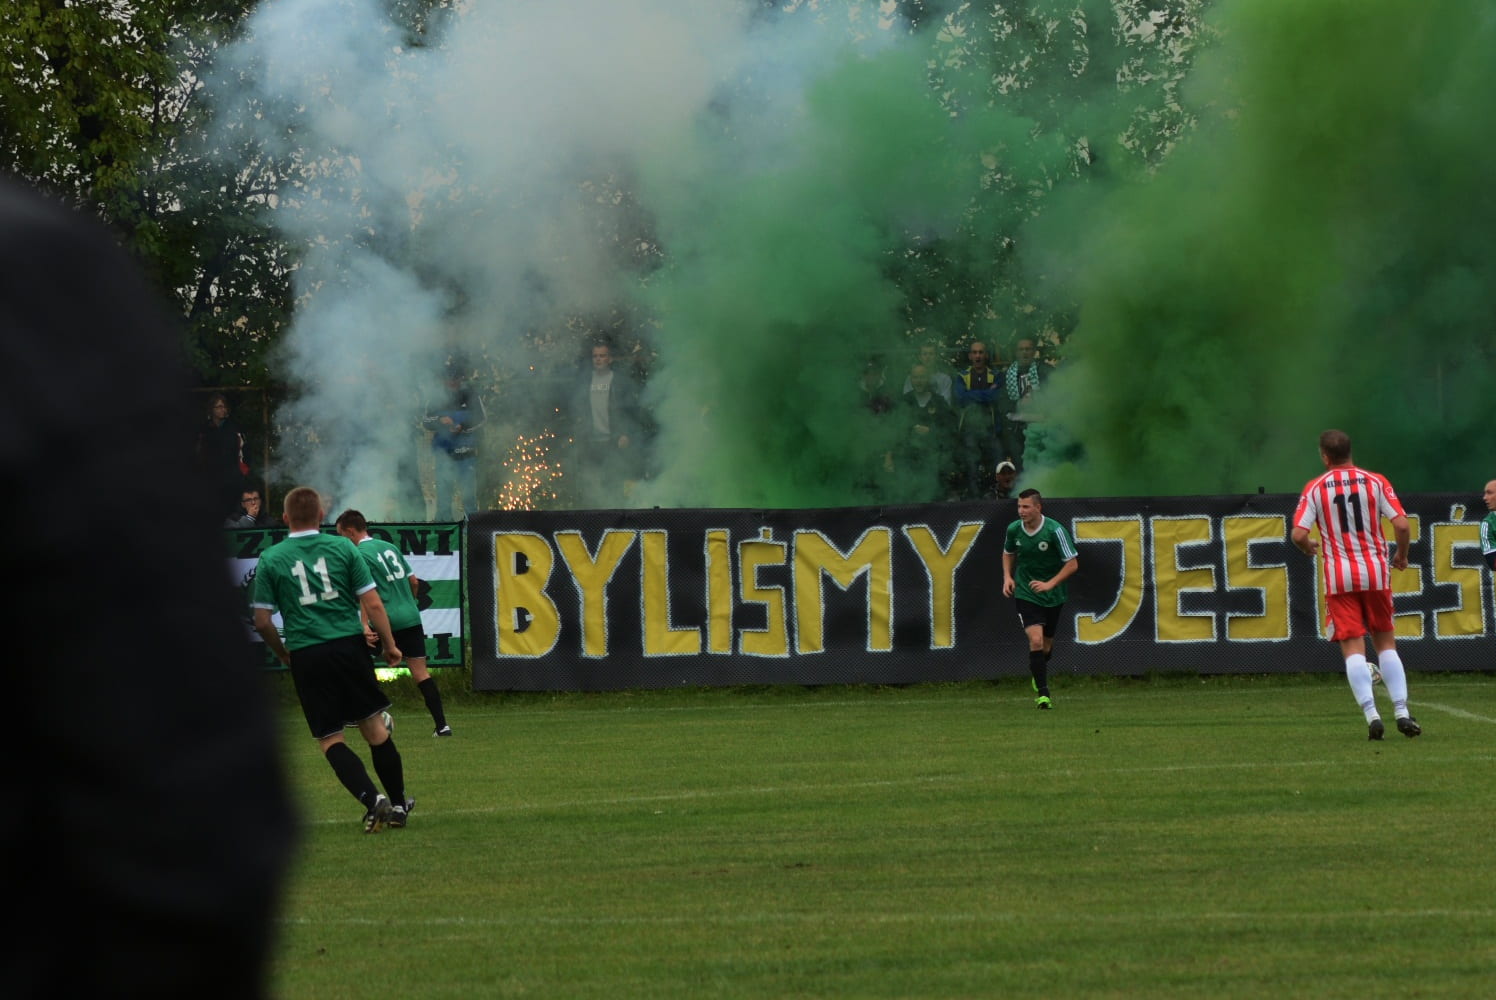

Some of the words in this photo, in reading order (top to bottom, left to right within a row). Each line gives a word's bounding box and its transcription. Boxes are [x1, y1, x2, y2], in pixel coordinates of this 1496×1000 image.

[1333, 492, 1364, 533] 11
[291, 557, 340, 606] 11
[377, 549, 406, 582] 13
[493, 521, 984, 658] BYLIŚMY
